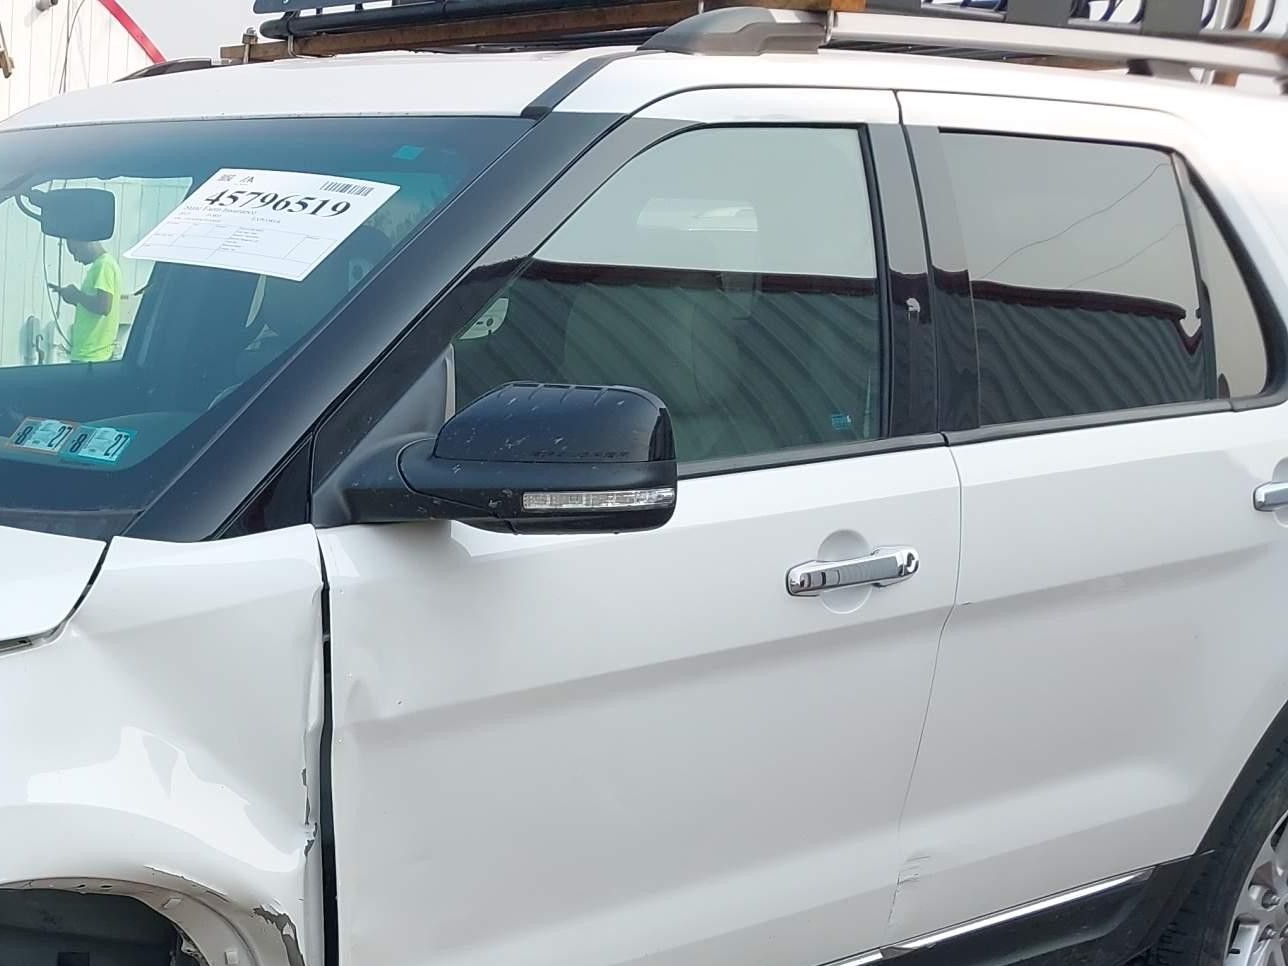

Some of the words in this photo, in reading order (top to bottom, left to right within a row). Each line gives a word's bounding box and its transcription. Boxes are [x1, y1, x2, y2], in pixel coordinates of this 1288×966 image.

[204, 188, 352, 218] 45796519
[47, 425, 74, 449] 27
[69, 433, 89, 453] 8
[103, 433, 130, 457] 27
